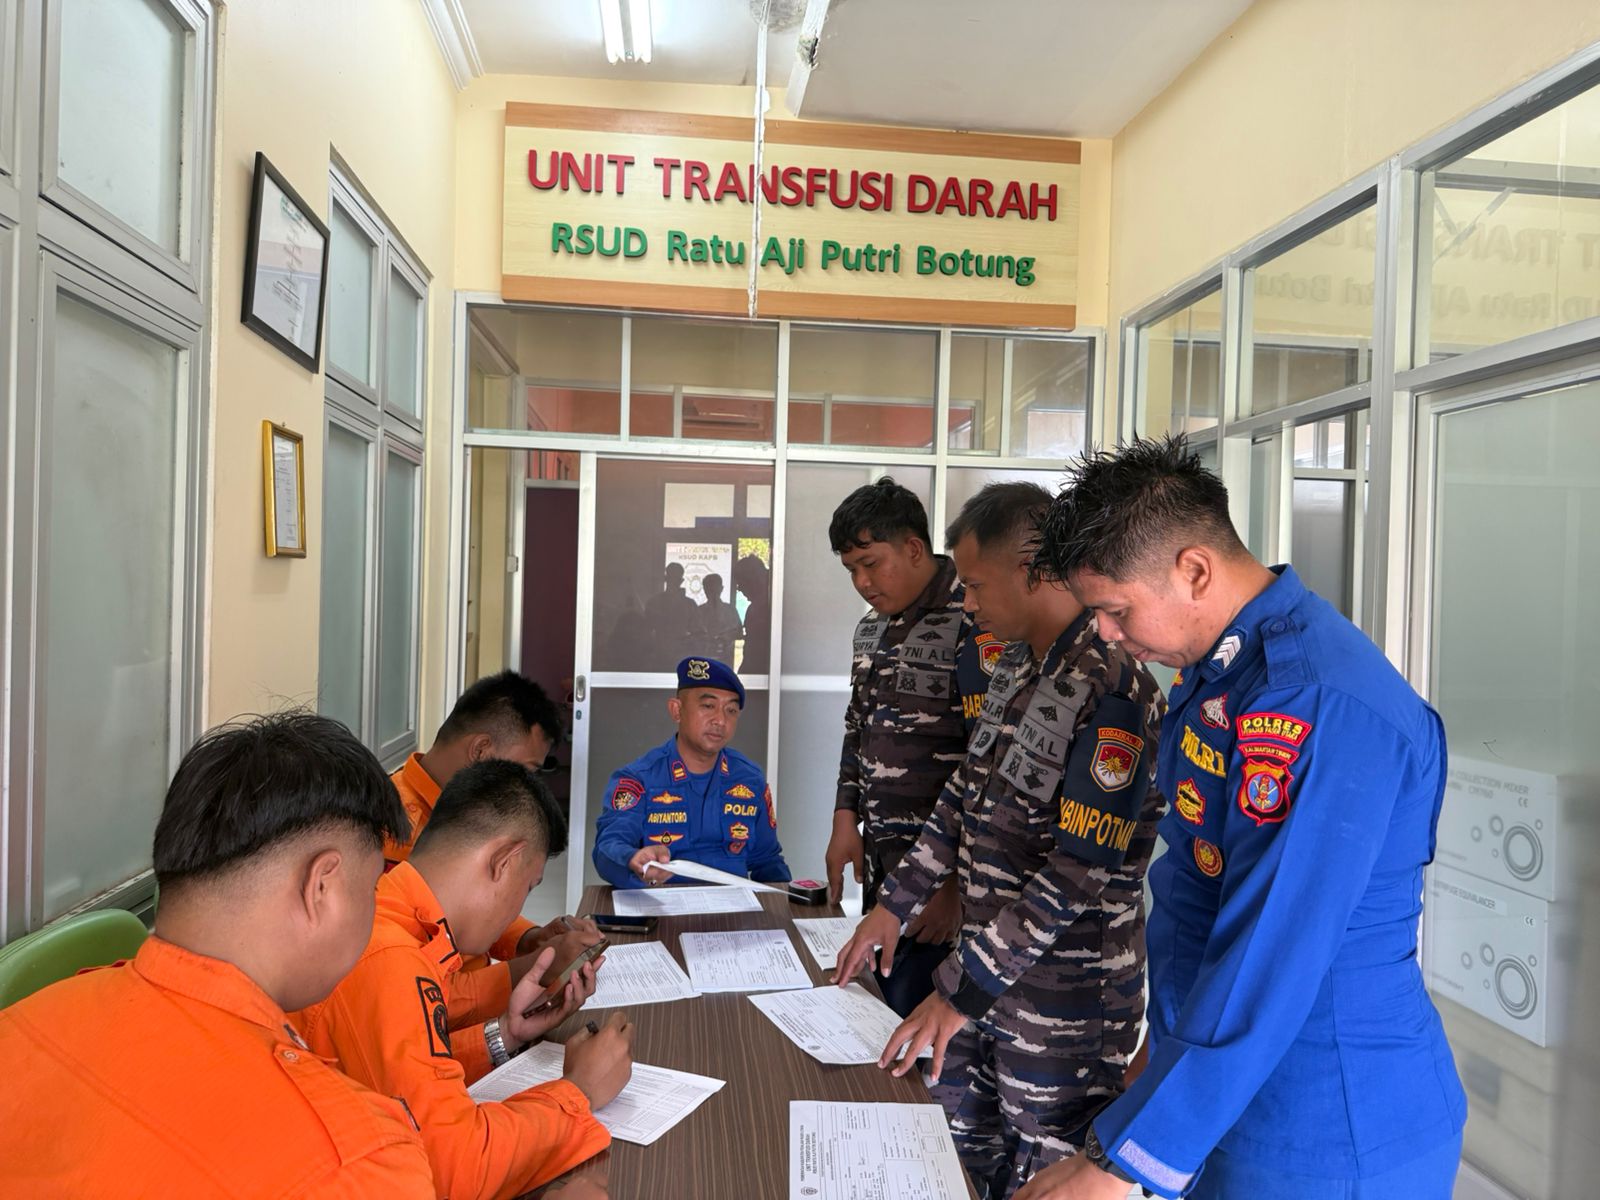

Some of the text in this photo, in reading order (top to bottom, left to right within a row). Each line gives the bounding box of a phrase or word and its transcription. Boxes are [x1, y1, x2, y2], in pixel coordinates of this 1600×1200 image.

[527, 149, 1059, 221] UNIT TRANSFUSI DARAH
[551, 222, 1036, 286] RSUD Ratu Aji Putri Botung
[904, 646, 923, 659] TNI
[1020, 723, 1037, 741] TNI
[1242, 717, 1303, 735] POLRES
[1503, 782, 1529, 795] MIXER
[724, 803, 757, 816] POLRI
